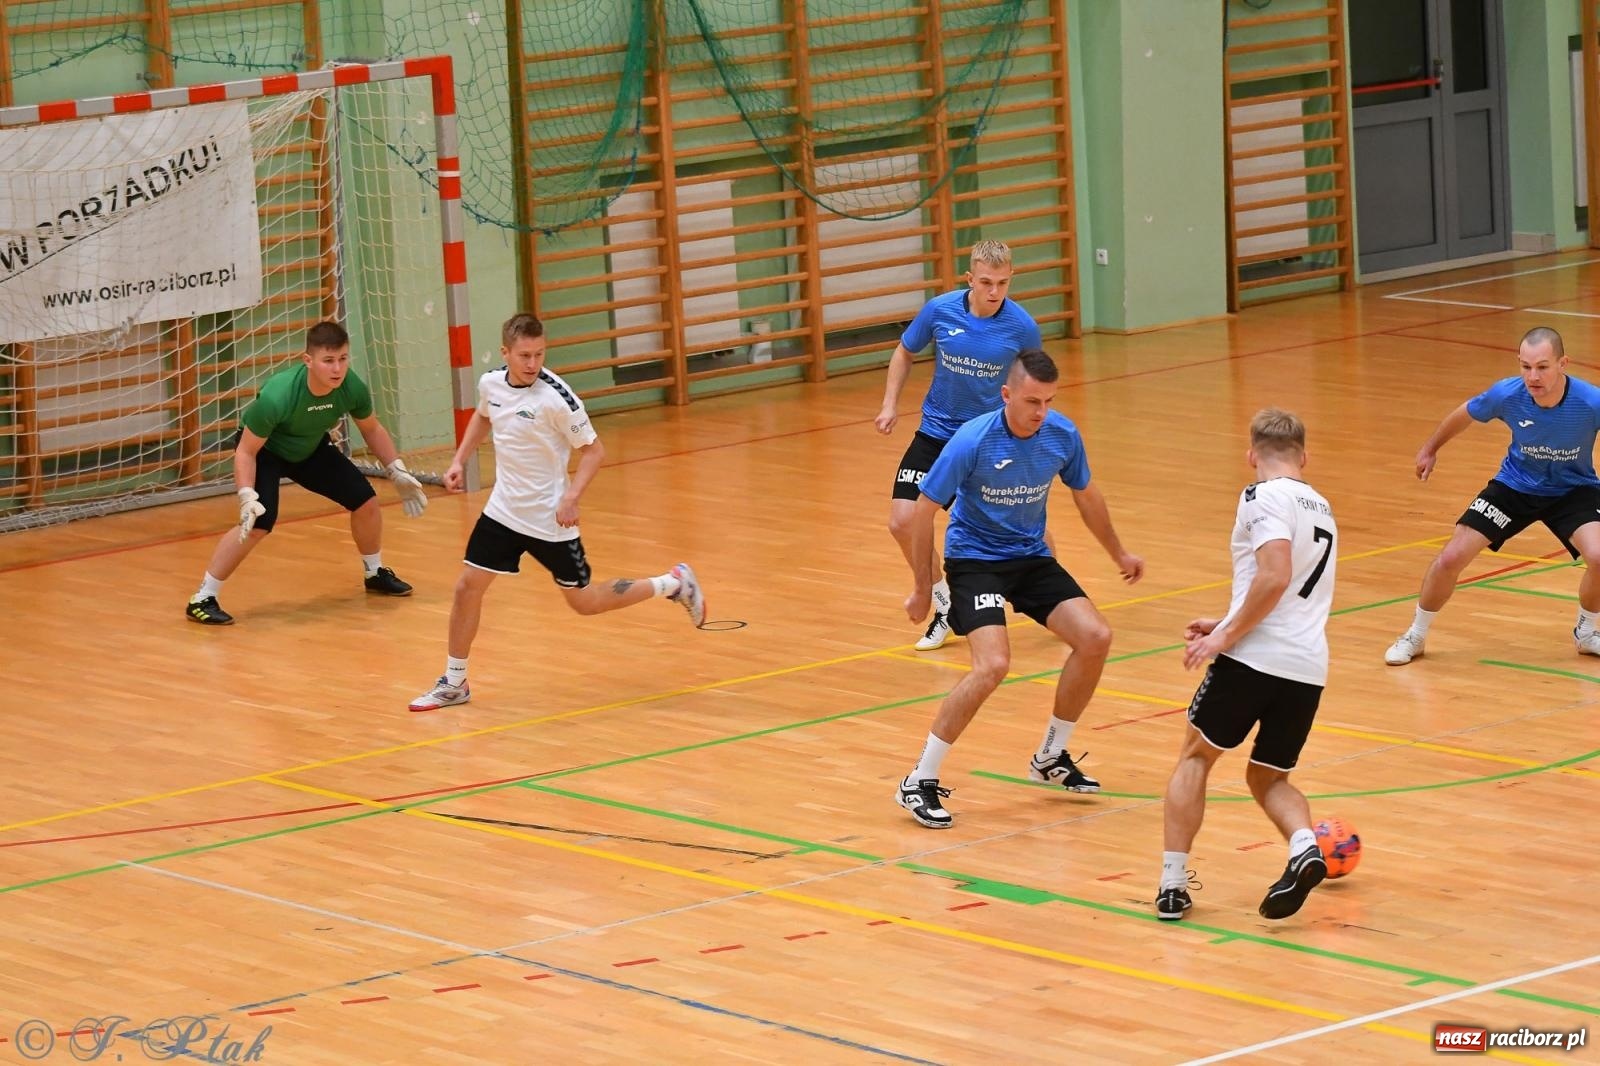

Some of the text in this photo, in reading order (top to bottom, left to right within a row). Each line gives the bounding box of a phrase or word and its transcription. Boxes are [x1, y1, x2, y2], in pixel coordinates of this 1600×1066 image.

[43, 263, 236, 309] www.osir-raciborz.pl
[897, 469, 916, 483] LSM
[1483, 504, 1512, 529] SPORT
[1297, 525, 1334, 599] 7
[974, 593, 996, 610] LSM
